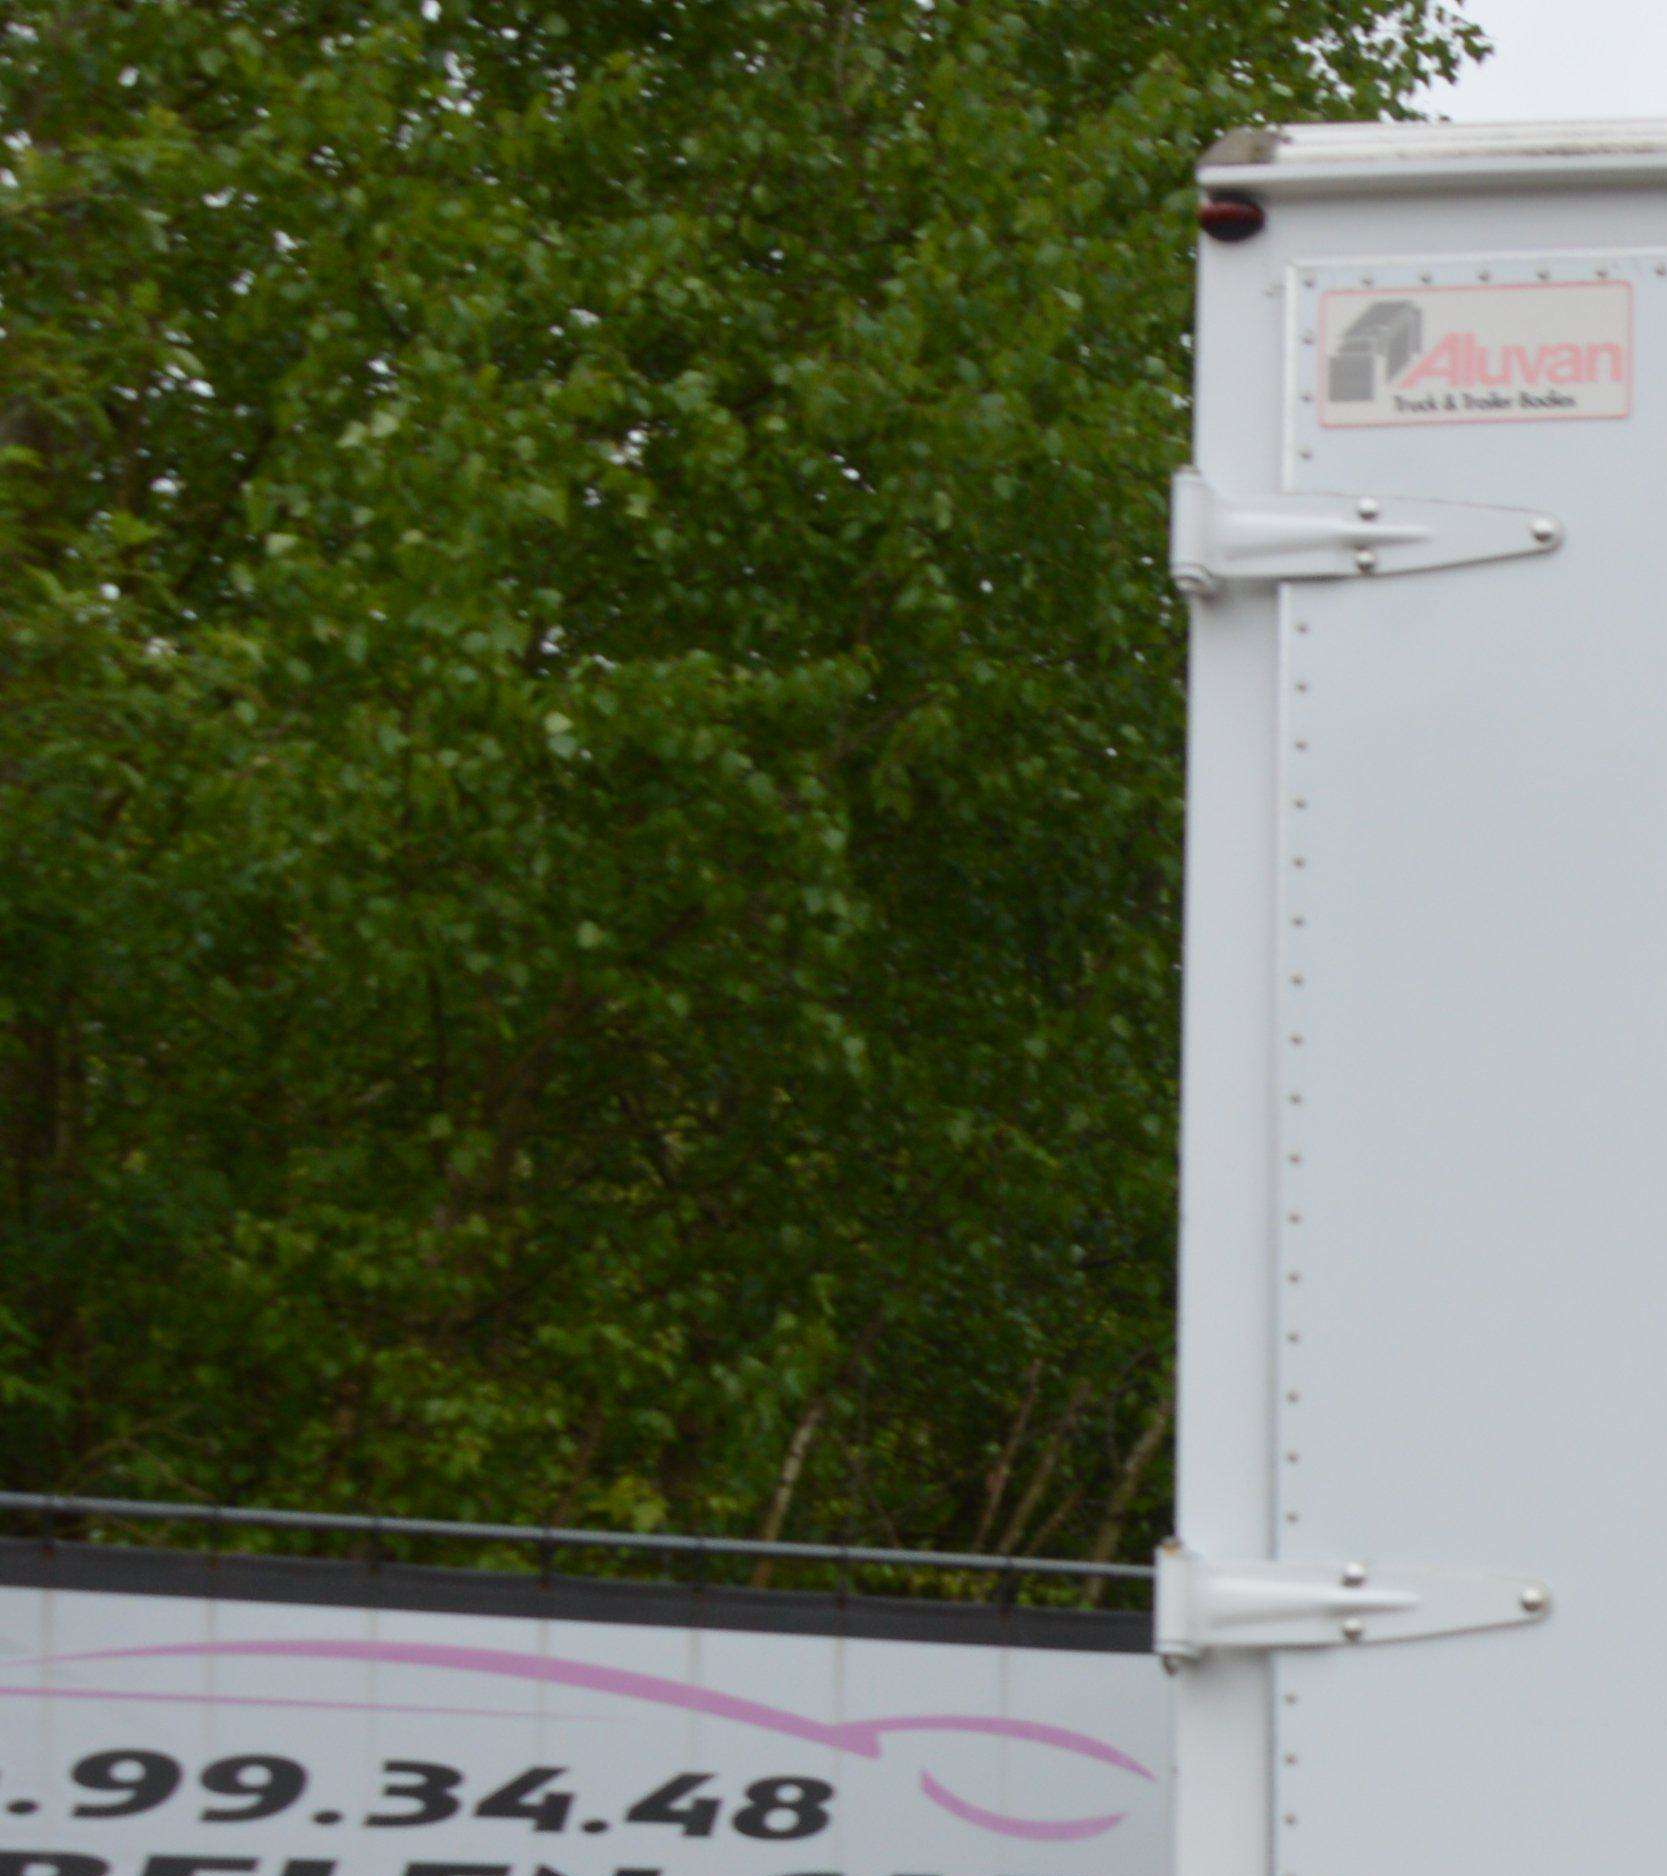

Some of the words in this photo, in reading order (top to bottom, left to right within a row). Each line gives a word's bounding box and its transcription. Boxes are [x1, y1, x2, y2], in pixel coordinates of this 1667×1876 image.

[1399, 332, 1624, 389] Aluvan
[1394, 394, 1438, 413] Truck
[7, 1748, 835, 1842] .99.34.48
